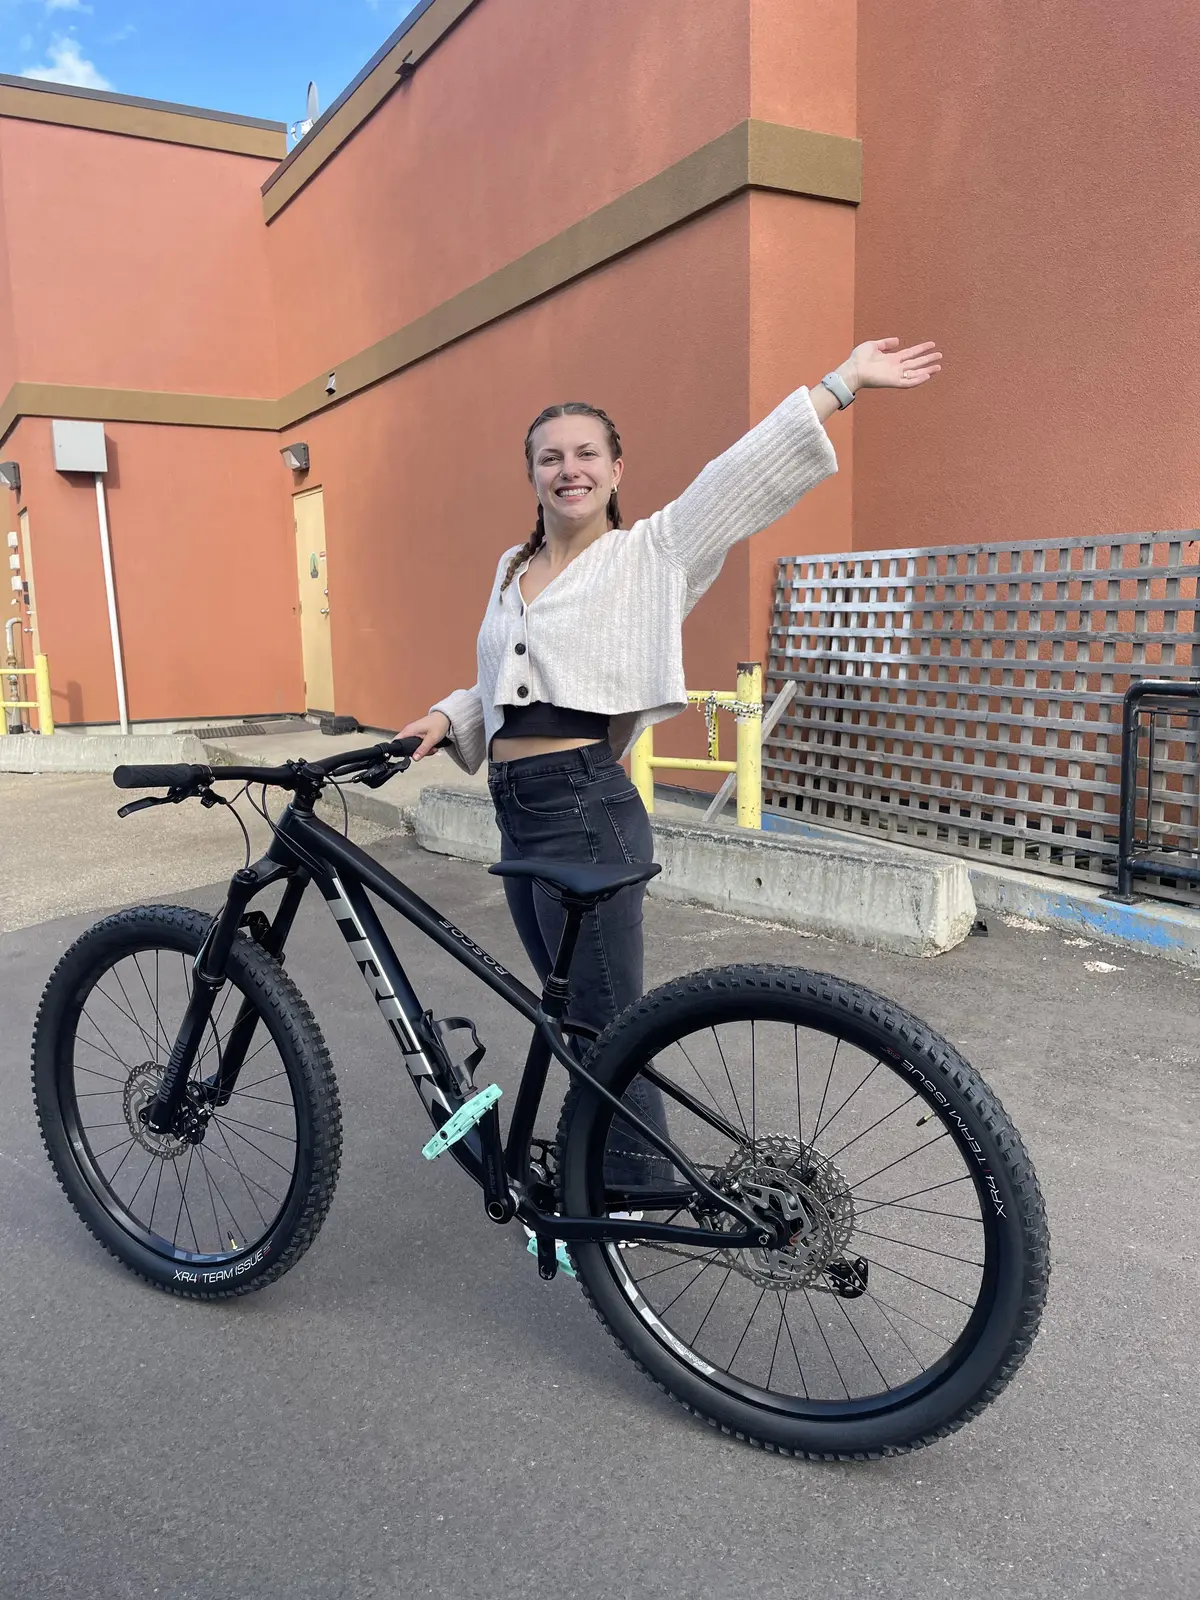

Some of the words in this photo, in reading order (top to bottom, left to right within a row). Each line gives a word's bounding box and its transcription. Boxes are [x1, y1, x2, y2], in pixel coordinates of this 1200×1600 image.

[438, 919, 509, 975] ROSCOE
[327, 878, 453, 1115] TREK
[900, 1058, 951, 1108] ISSUE
[948, 1110, 987, 1166] TEAM
[984, 1174, 1007, 1219] XR4
[173, 1269, 198, 1283] XR4
[202, 1267, 234, 1283] TEAM
[234, 1248, 264, 1276] ISSUE
